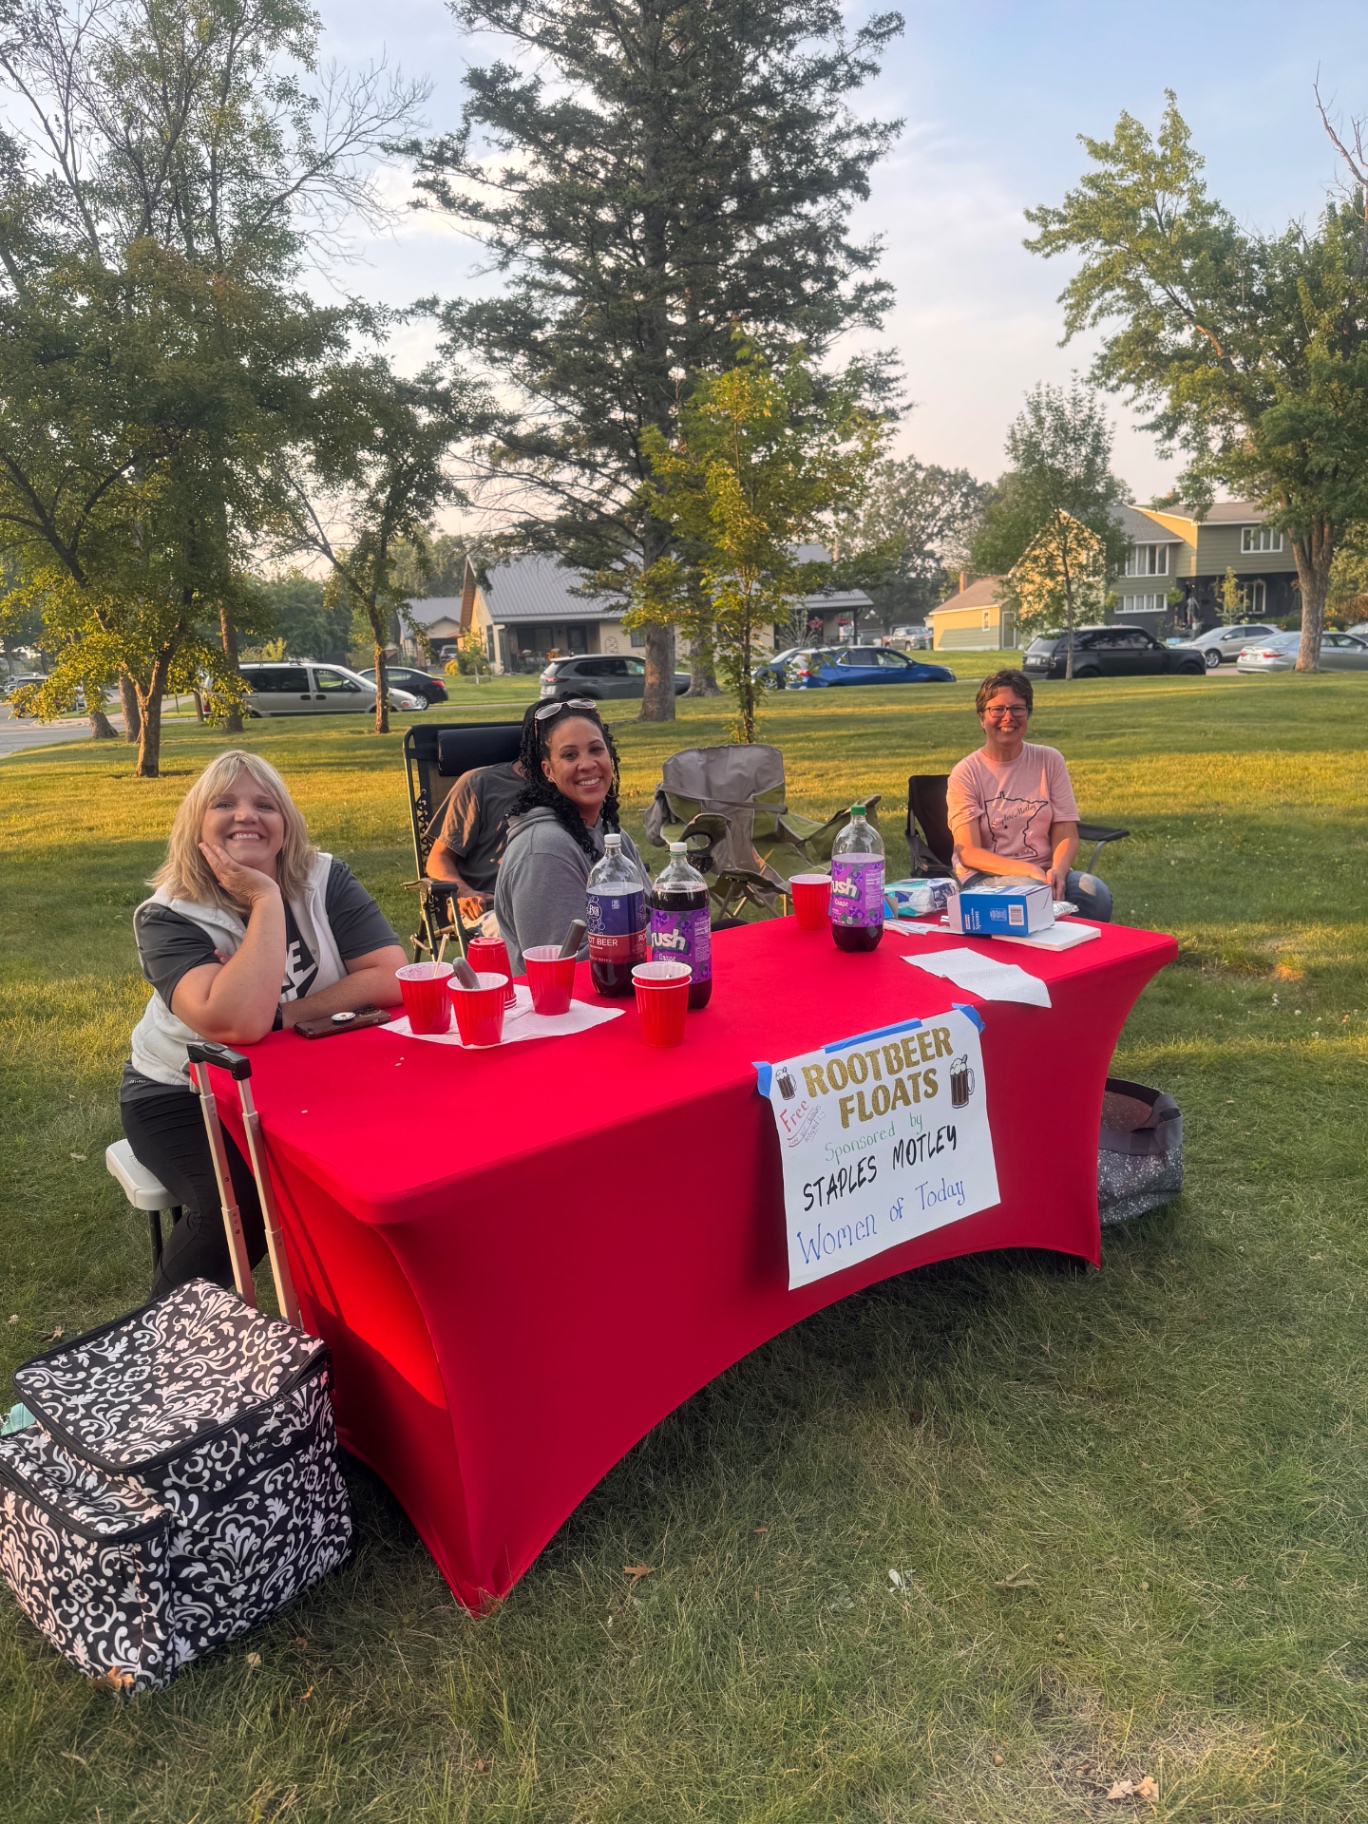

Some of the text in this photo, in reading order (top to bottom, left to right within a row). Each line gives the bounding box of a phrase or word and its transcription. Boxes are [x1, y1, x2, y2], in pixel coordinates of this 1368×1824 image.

[596, 938, 619, 947] BEER
[651, 928, 686, 951] rush
[801, 1026, 954, 1098] ROOTBEER
[779, 1100, 809, 1133] Free
[838, 1067, 939, 1129] FLOATS
[825, 1120, 896, 1166] Sponsored
[909, 1111, 923, 1135] by
[803, 1124, 957, 1212] STAPLES MOTLEY
[796, 1177, 967, 1265] Women of Today
